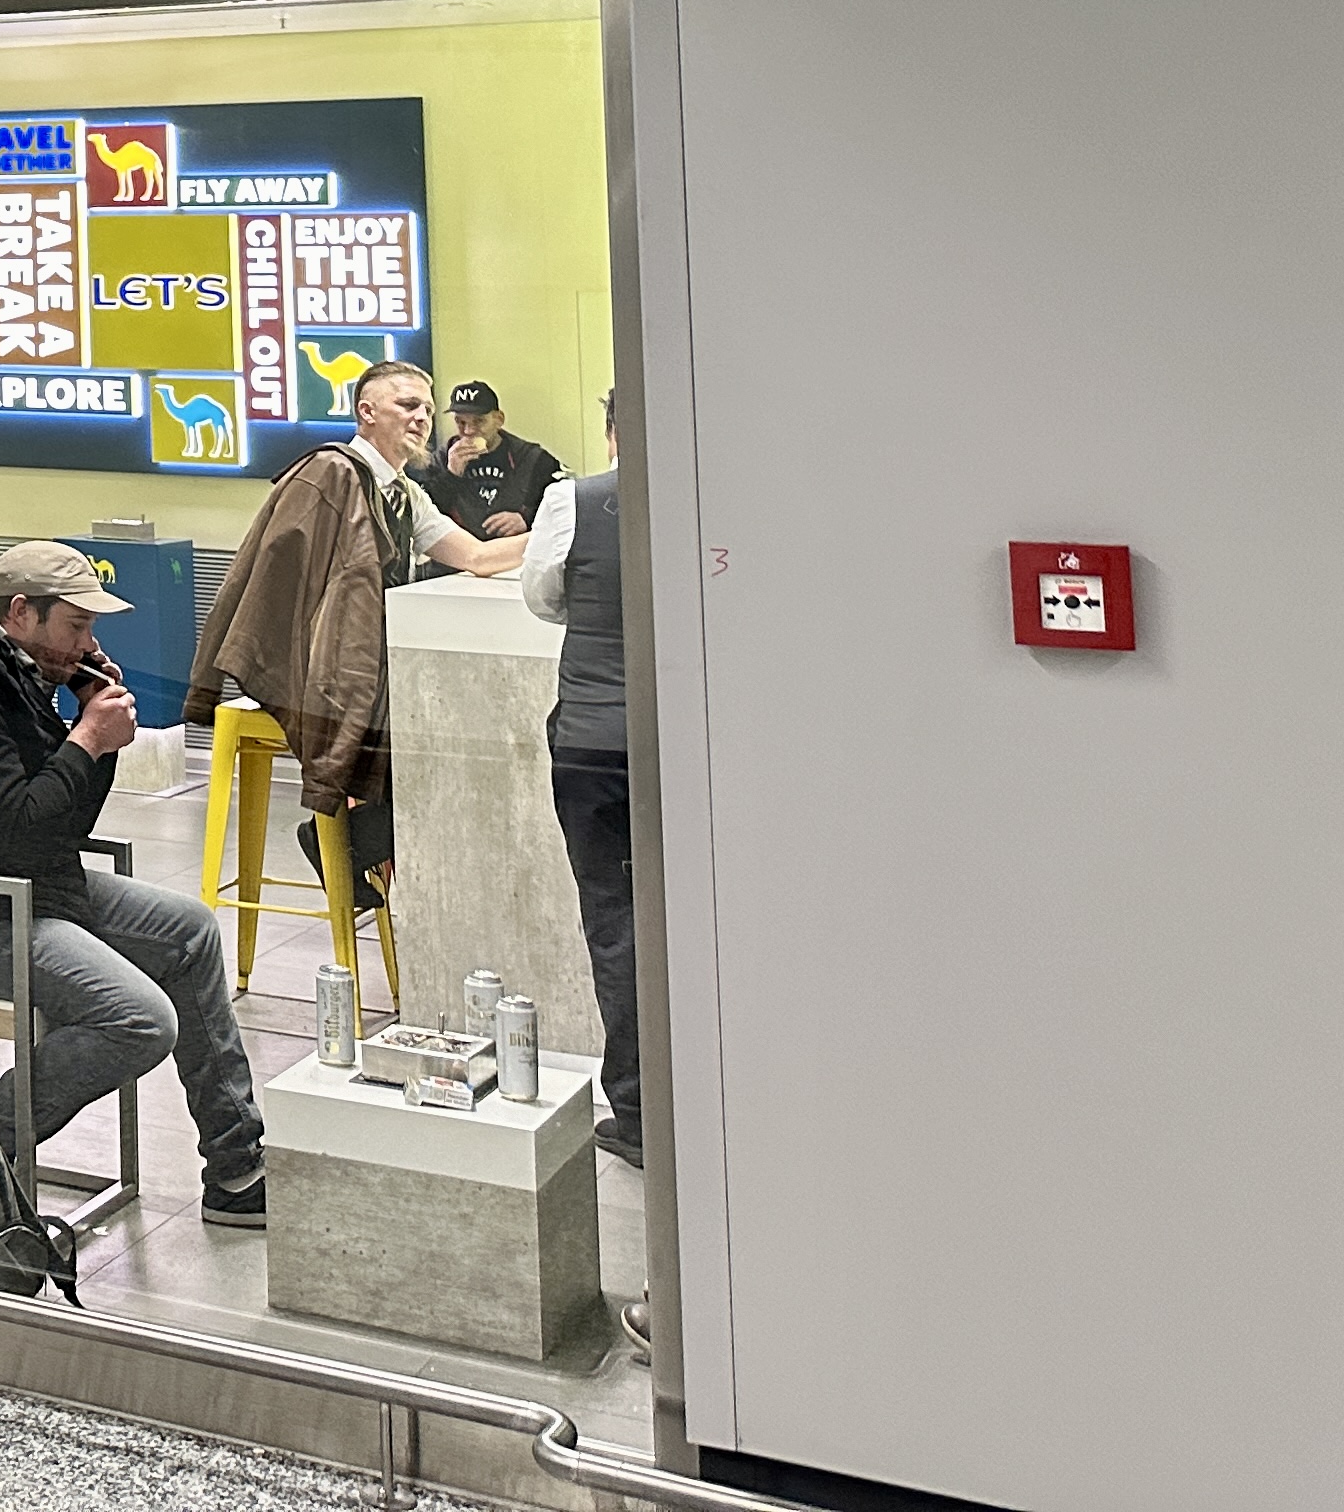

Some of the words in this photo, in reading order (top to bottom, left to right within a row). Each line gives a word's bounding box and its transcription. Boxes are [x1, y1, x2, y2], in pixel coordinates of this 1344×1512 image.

[180, 177, 228, 204] FLY
[234, 176, 326, 202] AWAY
[294, 218, 405, 245] ENJOY
[35, 190, 75, 311] TAKE
[295, 246, 405, 286] THE
[92, 273, 229, 311] LET'S
[244, 218, 280, 329] CHILL
[296, 288, 408, 325] RIDE
[38, 326, 76, 359] A
[248, 347, 284, 417] OUT
[455, 388, 480, 403] NY
[709, 548, 729, 577] 3
